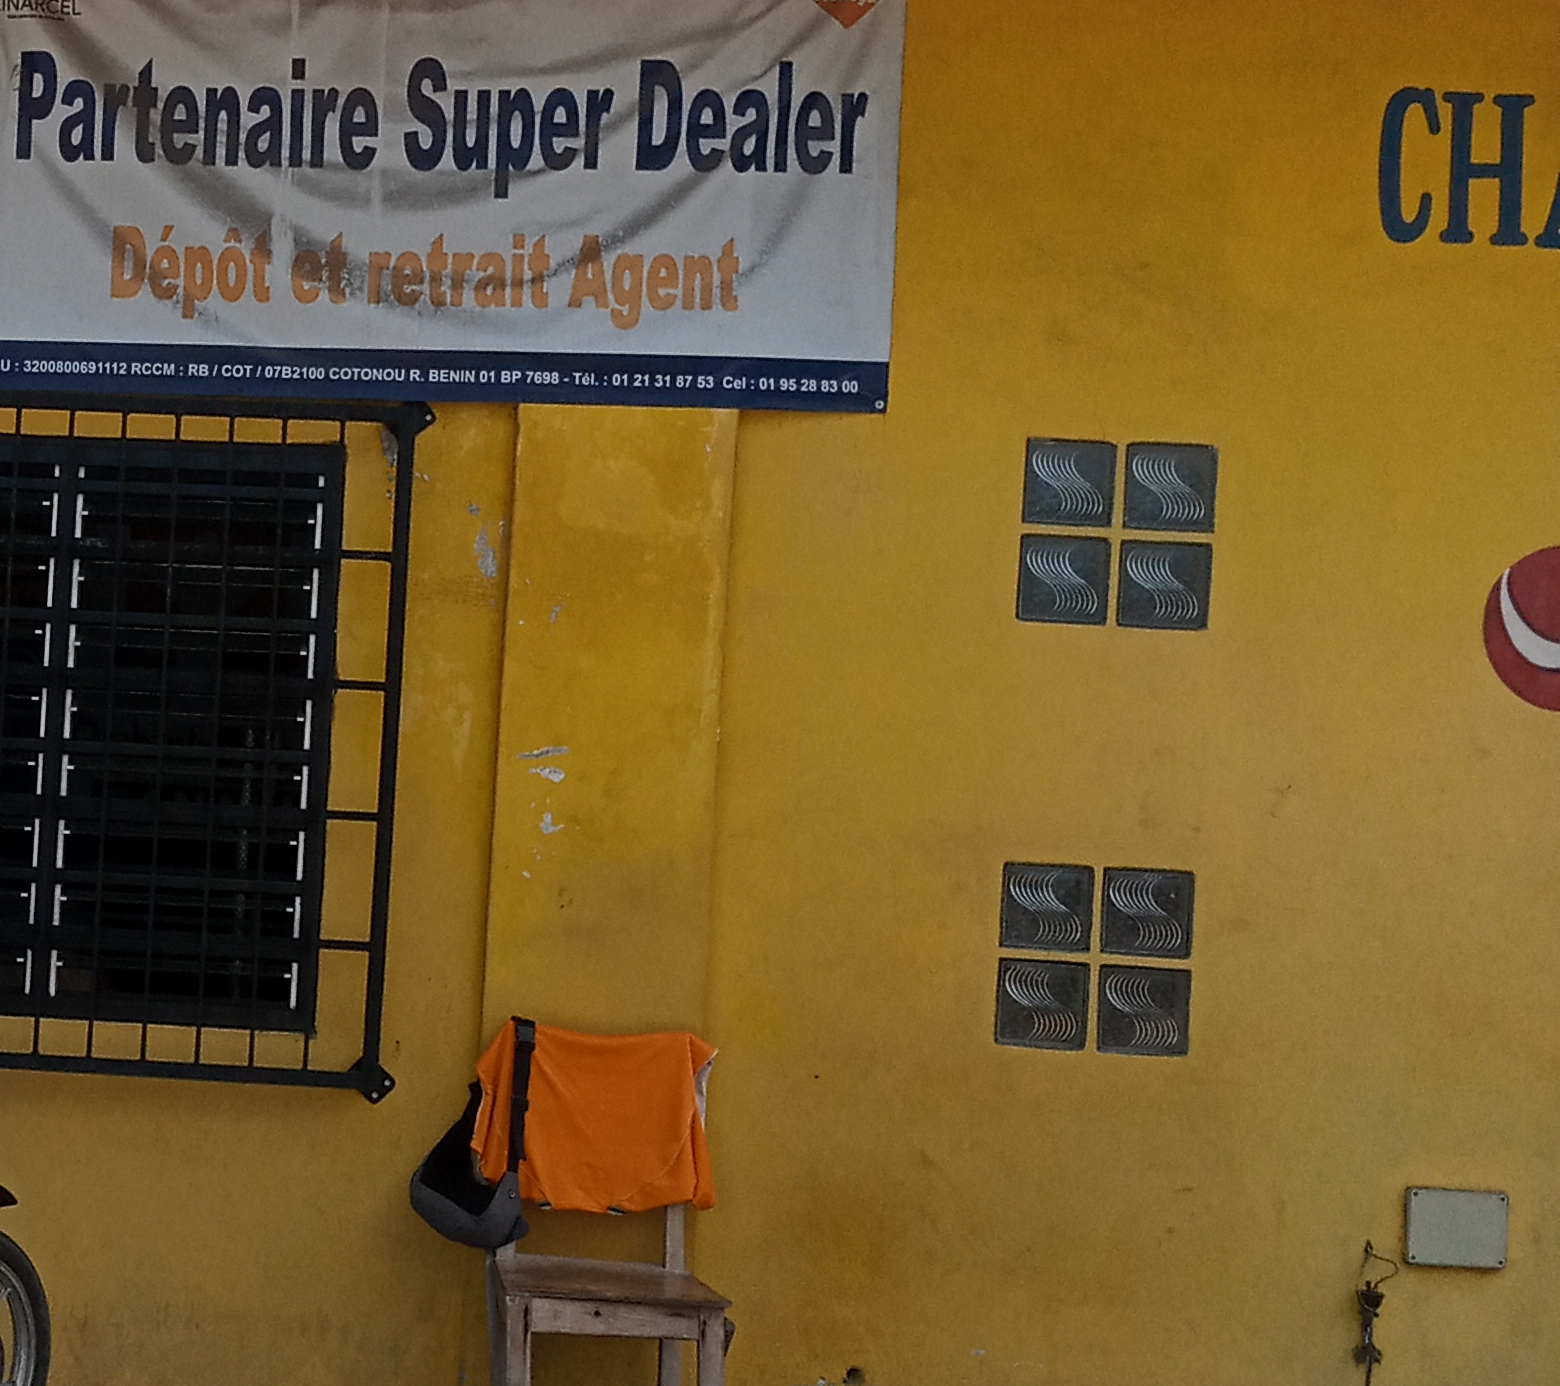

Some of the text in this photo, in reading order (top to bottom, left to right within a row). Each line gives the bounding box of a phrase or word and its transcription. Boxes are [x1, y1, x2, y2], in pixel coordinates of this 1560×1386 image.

[14, 49, 869, 200] Partenaire Super Dealer
[1378, 85, 1560, 250] CH
[109, 223, 741, 331] Dépôt et retrait Agent
[23, 359, 127, 375] 3200800691112
[130, 362, 175, 377] RCCM
[188, 363, 209, 377] RB
[221, 364, 253, 379] COT
[264, 365, 325, 380] 07B2100
[329, 367, 405, 382] COTONOU
[409, 368, 424, 383] R.
[428, 369, 475, 383] BENIN
[479, 370, 495, 384] 01
[500, 370, 521, 384] BP
[526, 371, 559, 385] 7698
[612, 373, 628, 388] 01
[633, 373, 650, 388] 21
[654, 373, 671, 388] 31
[675, 374, 693, 389] 87
[697, 375, 714, 389] 53
[722, 375, 746, 390] Cel
[759, 376, 775, 391] 01
[779, 377, 797, 391] 95
[800, 378, 817, 392] 28
[821, 378, 838, 393] 83
[841, 380, 859, 394] 00
